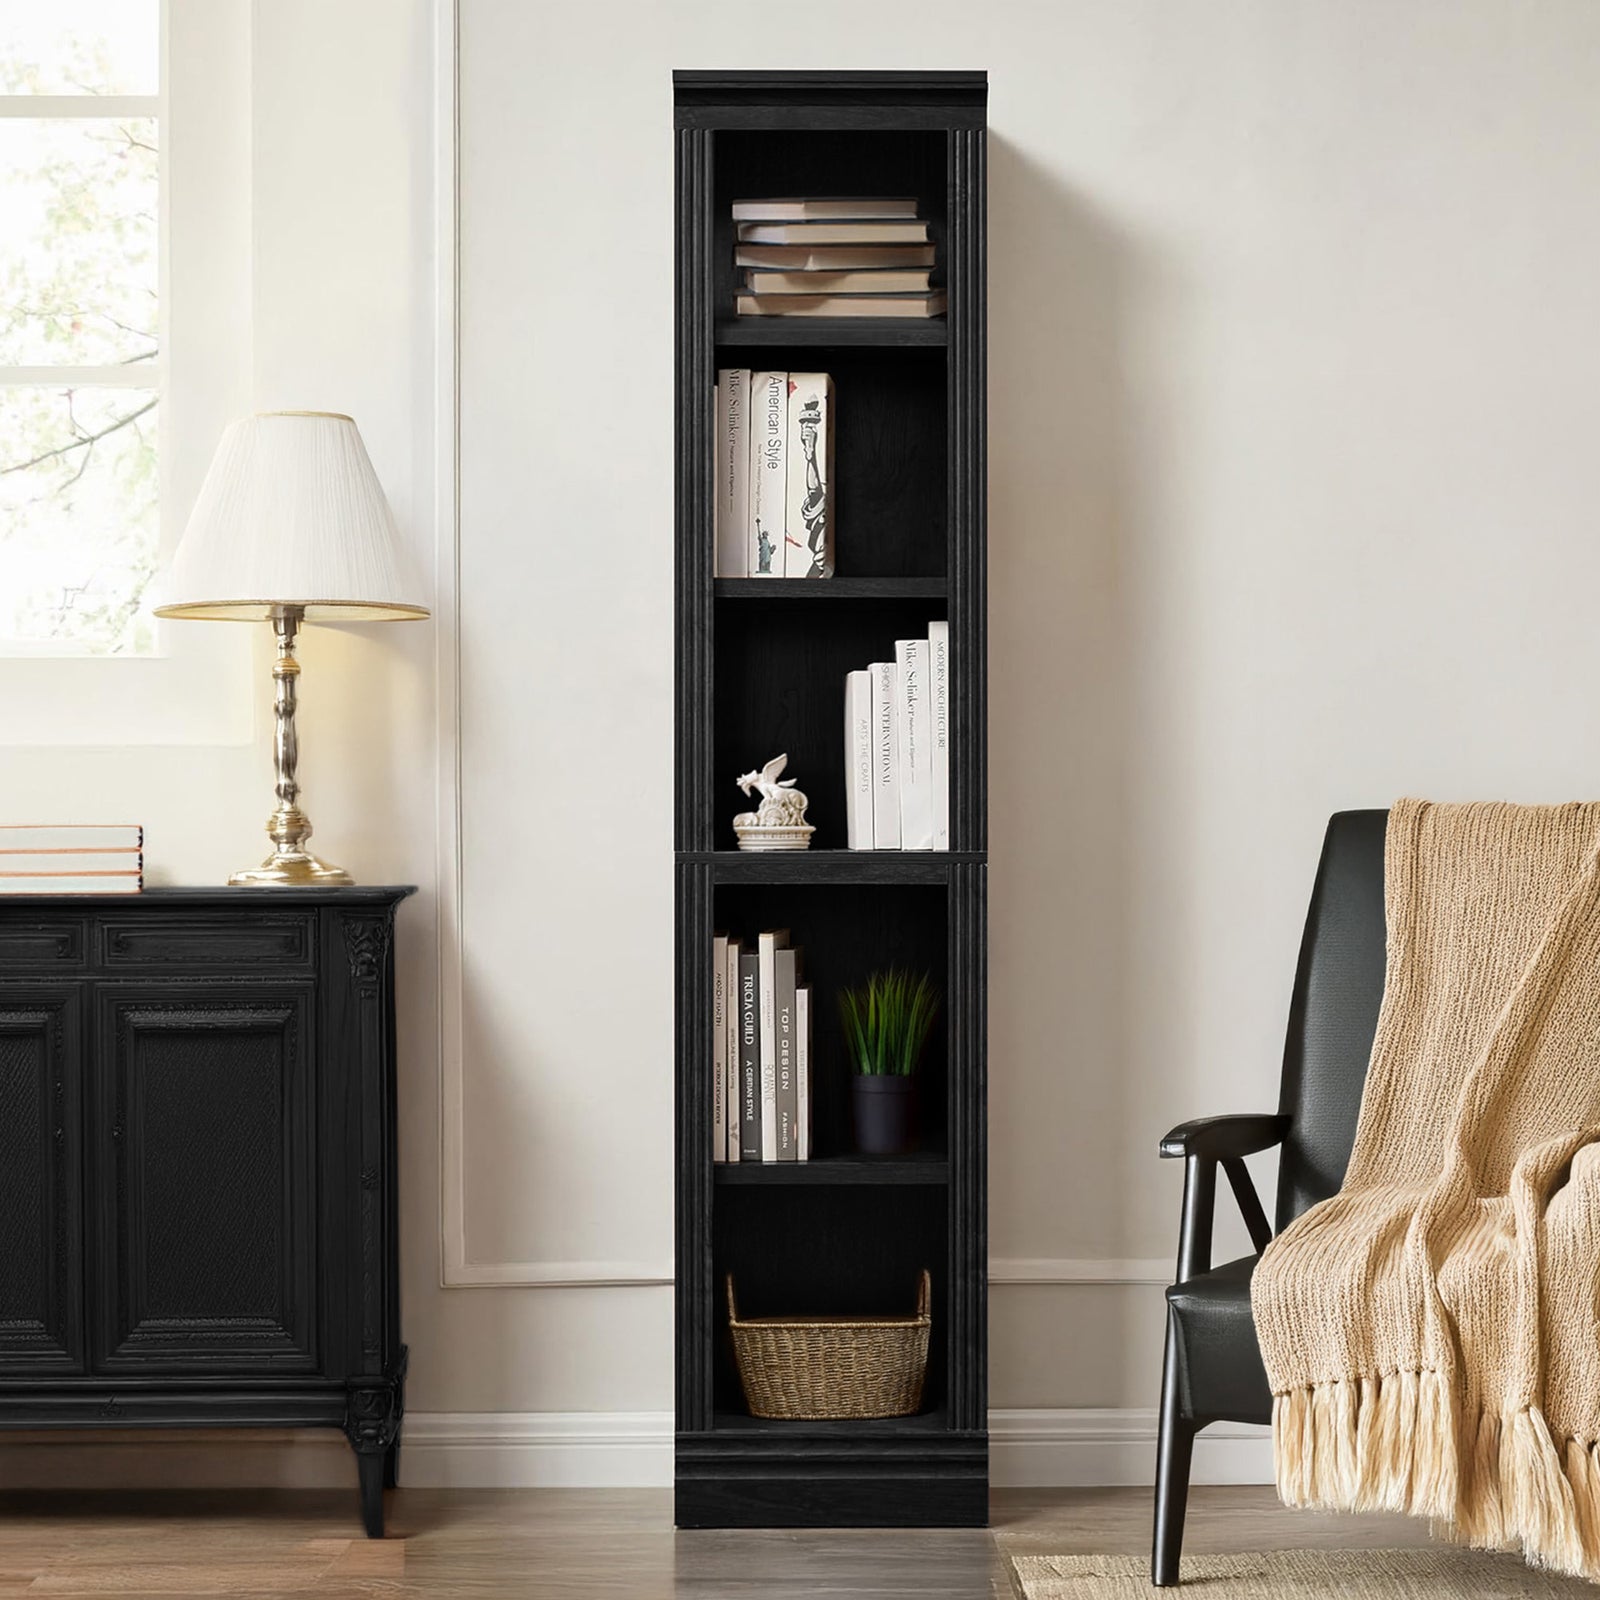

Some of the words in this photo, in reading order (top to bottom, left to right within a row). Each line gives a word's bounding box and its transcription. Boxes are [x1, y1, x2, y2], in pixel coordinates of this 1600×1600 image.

[728, 398, 740, 445] Selinker
[768, 376, 783, 435] American
[764, 438, 782, 470] Style
[937, 641, 945, 681] MODERN
[906, 670, 918, 716] Selinker
[860, 719, 868, 740] ARTS
[937, 684, 946, 749] ARCHITECTURE
[860, 743, 868, 758] THE
[882, 701, 891, 787] INTERNATIONAL
[861, 762, 869, 793] CRAFTS
[744, 974, 754, 1010] TRICIA
[744, 1011, 755, 1045] GUILD
[781, 1007, 789, 1033] TOP
[781, 1040, 789, 1090] DESIGN
[746, 1099, 754, 1121] STYLE
